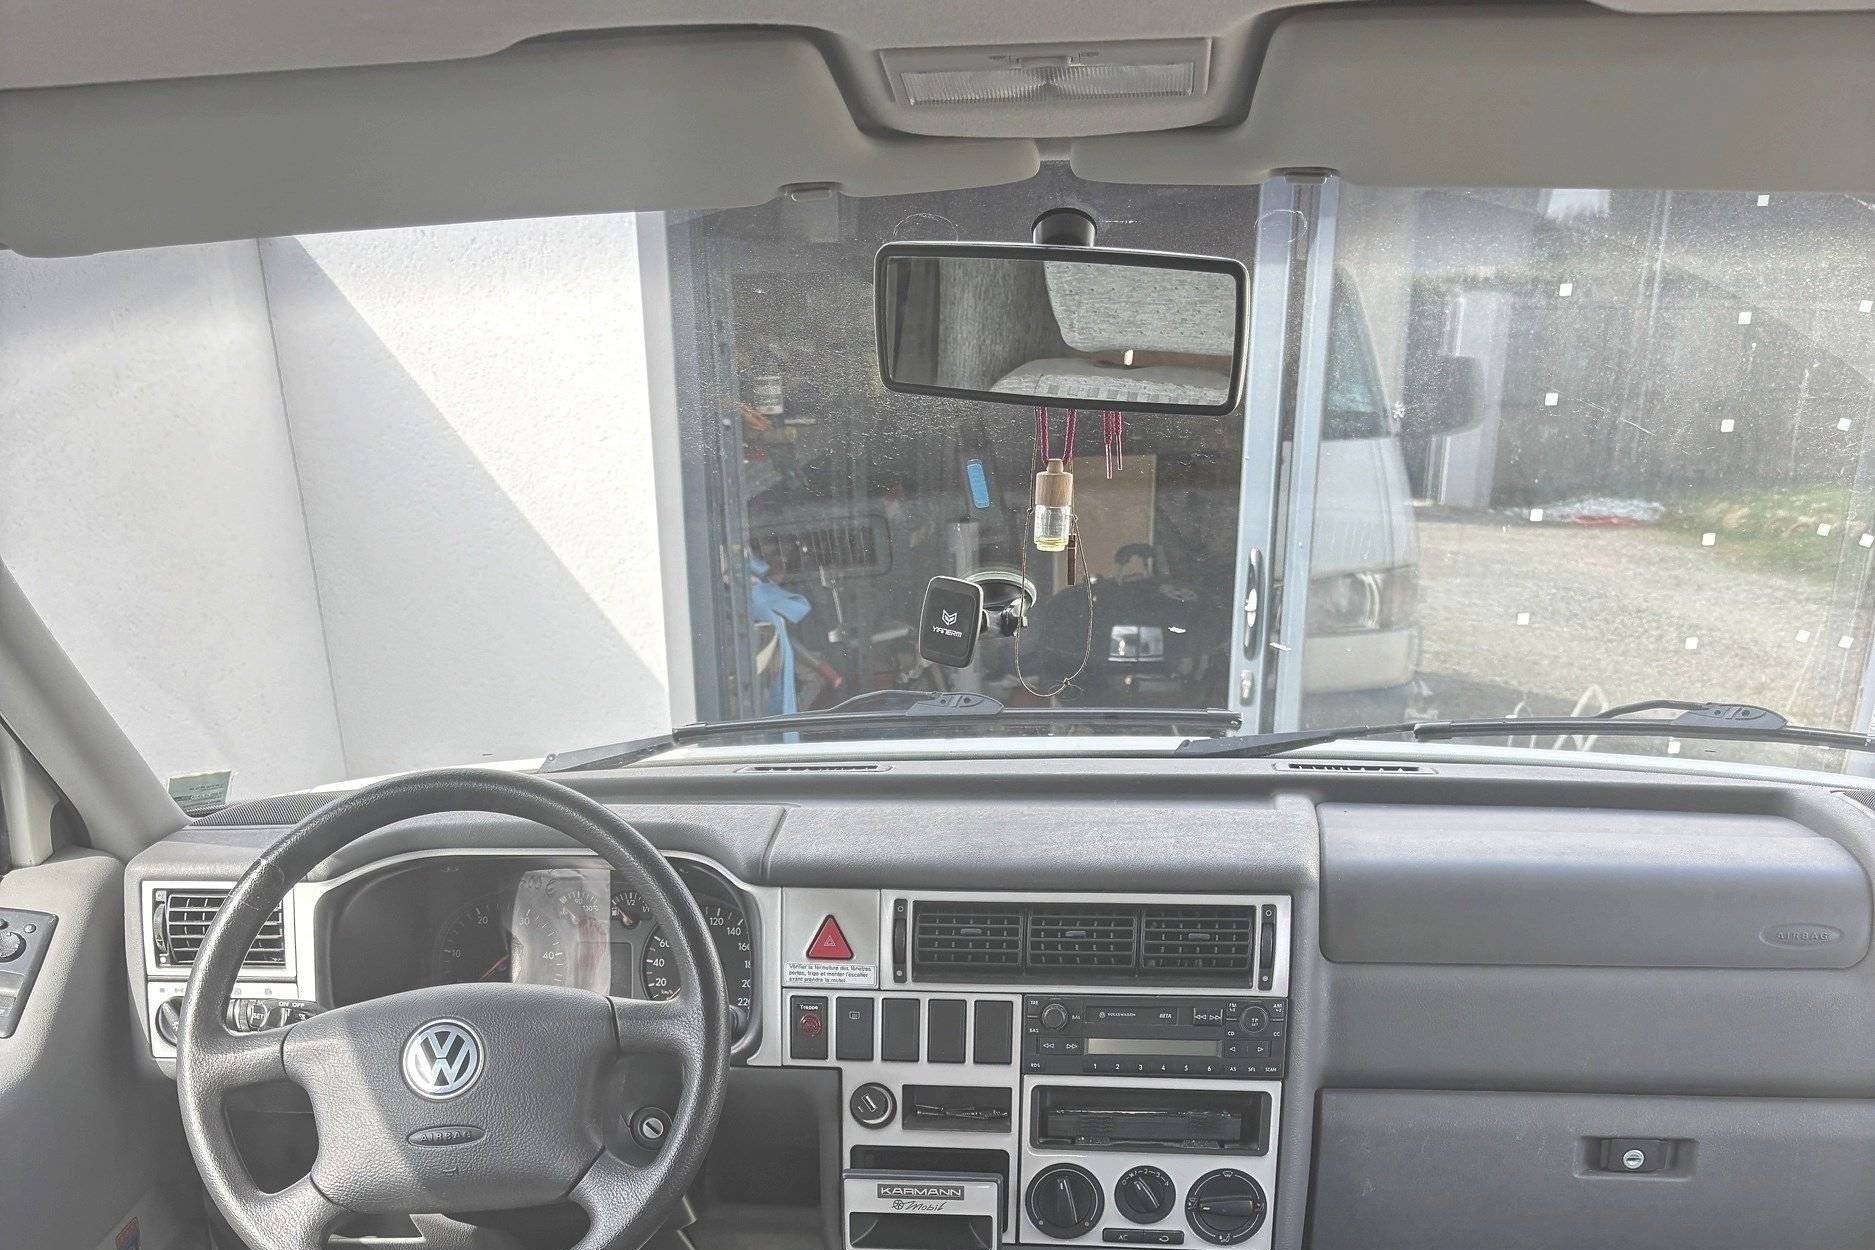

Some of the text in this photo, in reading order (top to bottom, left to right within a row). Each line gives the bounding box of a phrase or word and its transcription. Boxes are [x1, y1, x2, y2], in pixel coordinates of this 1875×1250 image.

[478, 915, 489, 925] 20
[520, 917, 530, 926] 30
[709, 917, 724, 926] 120
[726, 927, 742, 936] 140
[1777, 931, 1829, 941] AIRBAG
[452, 949, 461, 958] 10
[543, 951, 555, 960] 40
[653, 958, 665, 968] 40
[655, 977, 667, 987] 20
[252, 1012, 264, 1020] SET
[406, 1022, 481, 1097] VW
[420, 1130, 472, 1141] AIRBAG
[880, 1187, 961, 1197] KARMANN
[904, 1200, 948, 1212] Mobil
